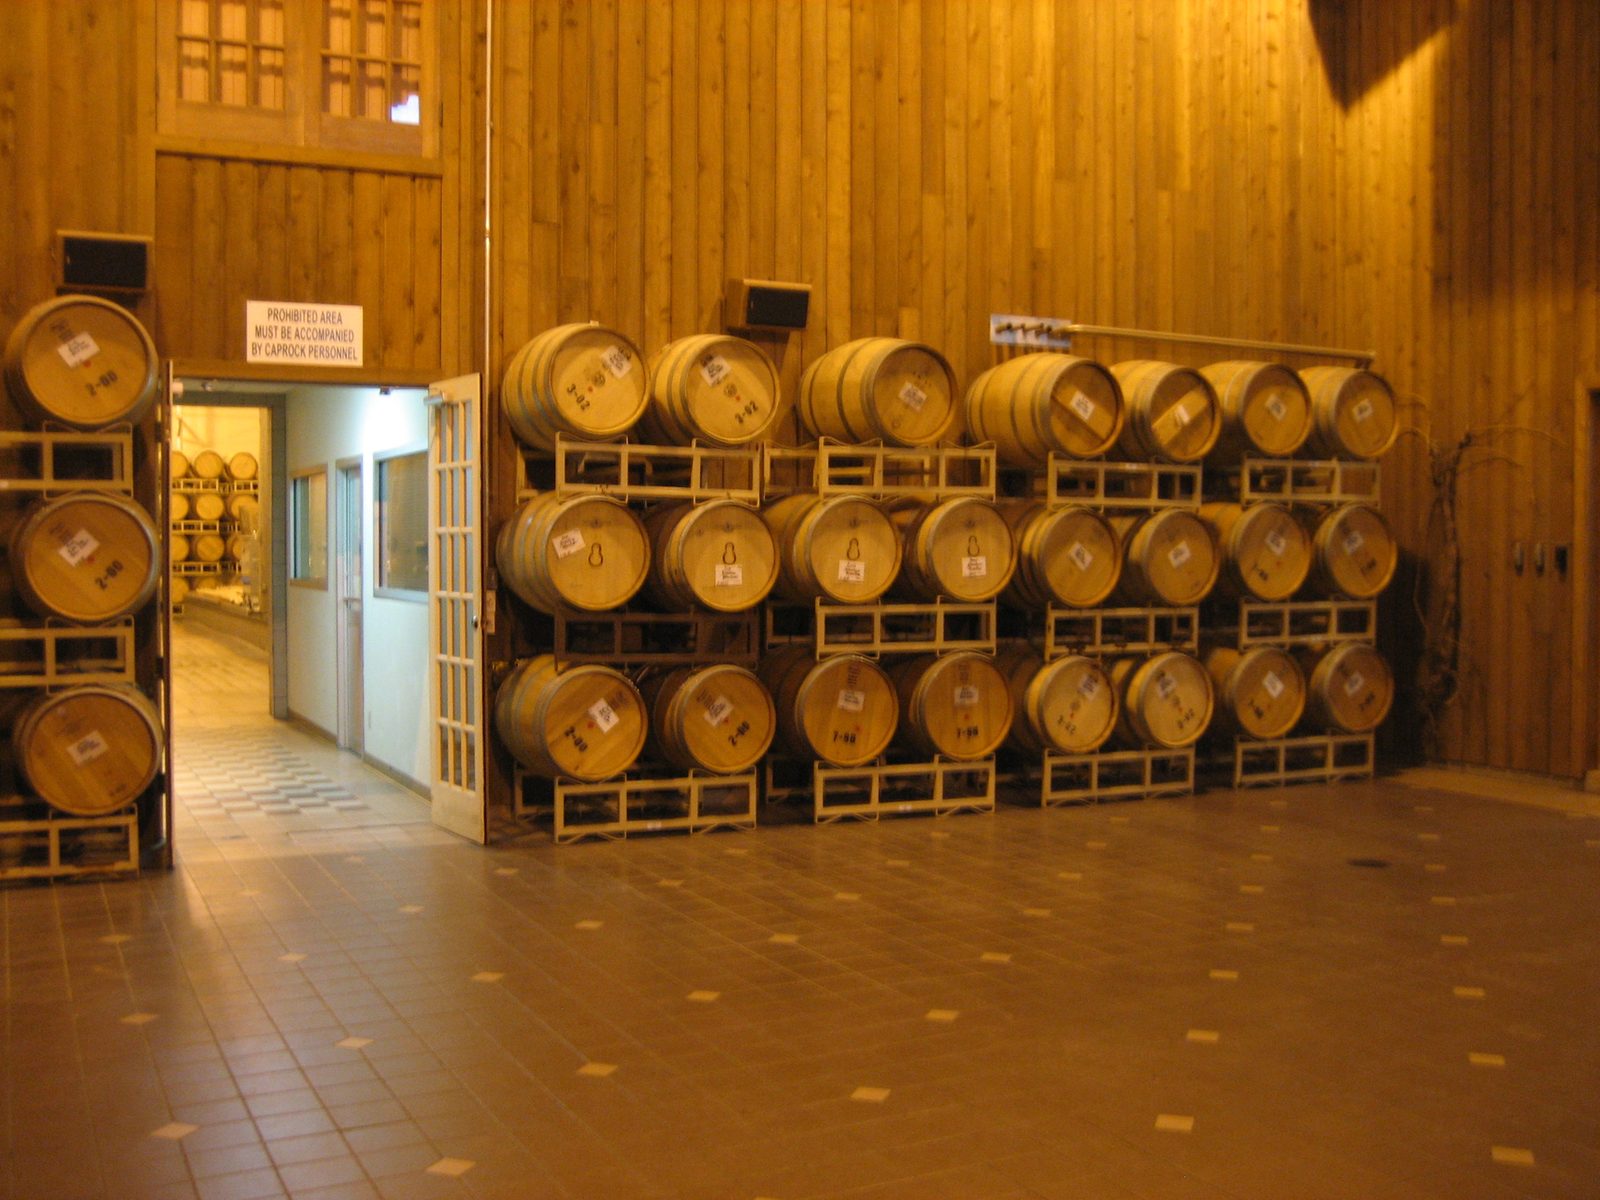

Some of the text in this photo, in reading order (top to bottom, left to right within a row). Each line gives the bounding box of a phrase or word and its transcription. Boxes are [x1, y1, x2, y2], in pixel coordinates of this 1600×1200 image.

[267, 307, 343, 325] PROHIBITED AREA
[255, 325, 354, 343] MUST BE ACCOMPANIED
[251, 342, 358, 361] BY CAPROCK PERSONNEL
